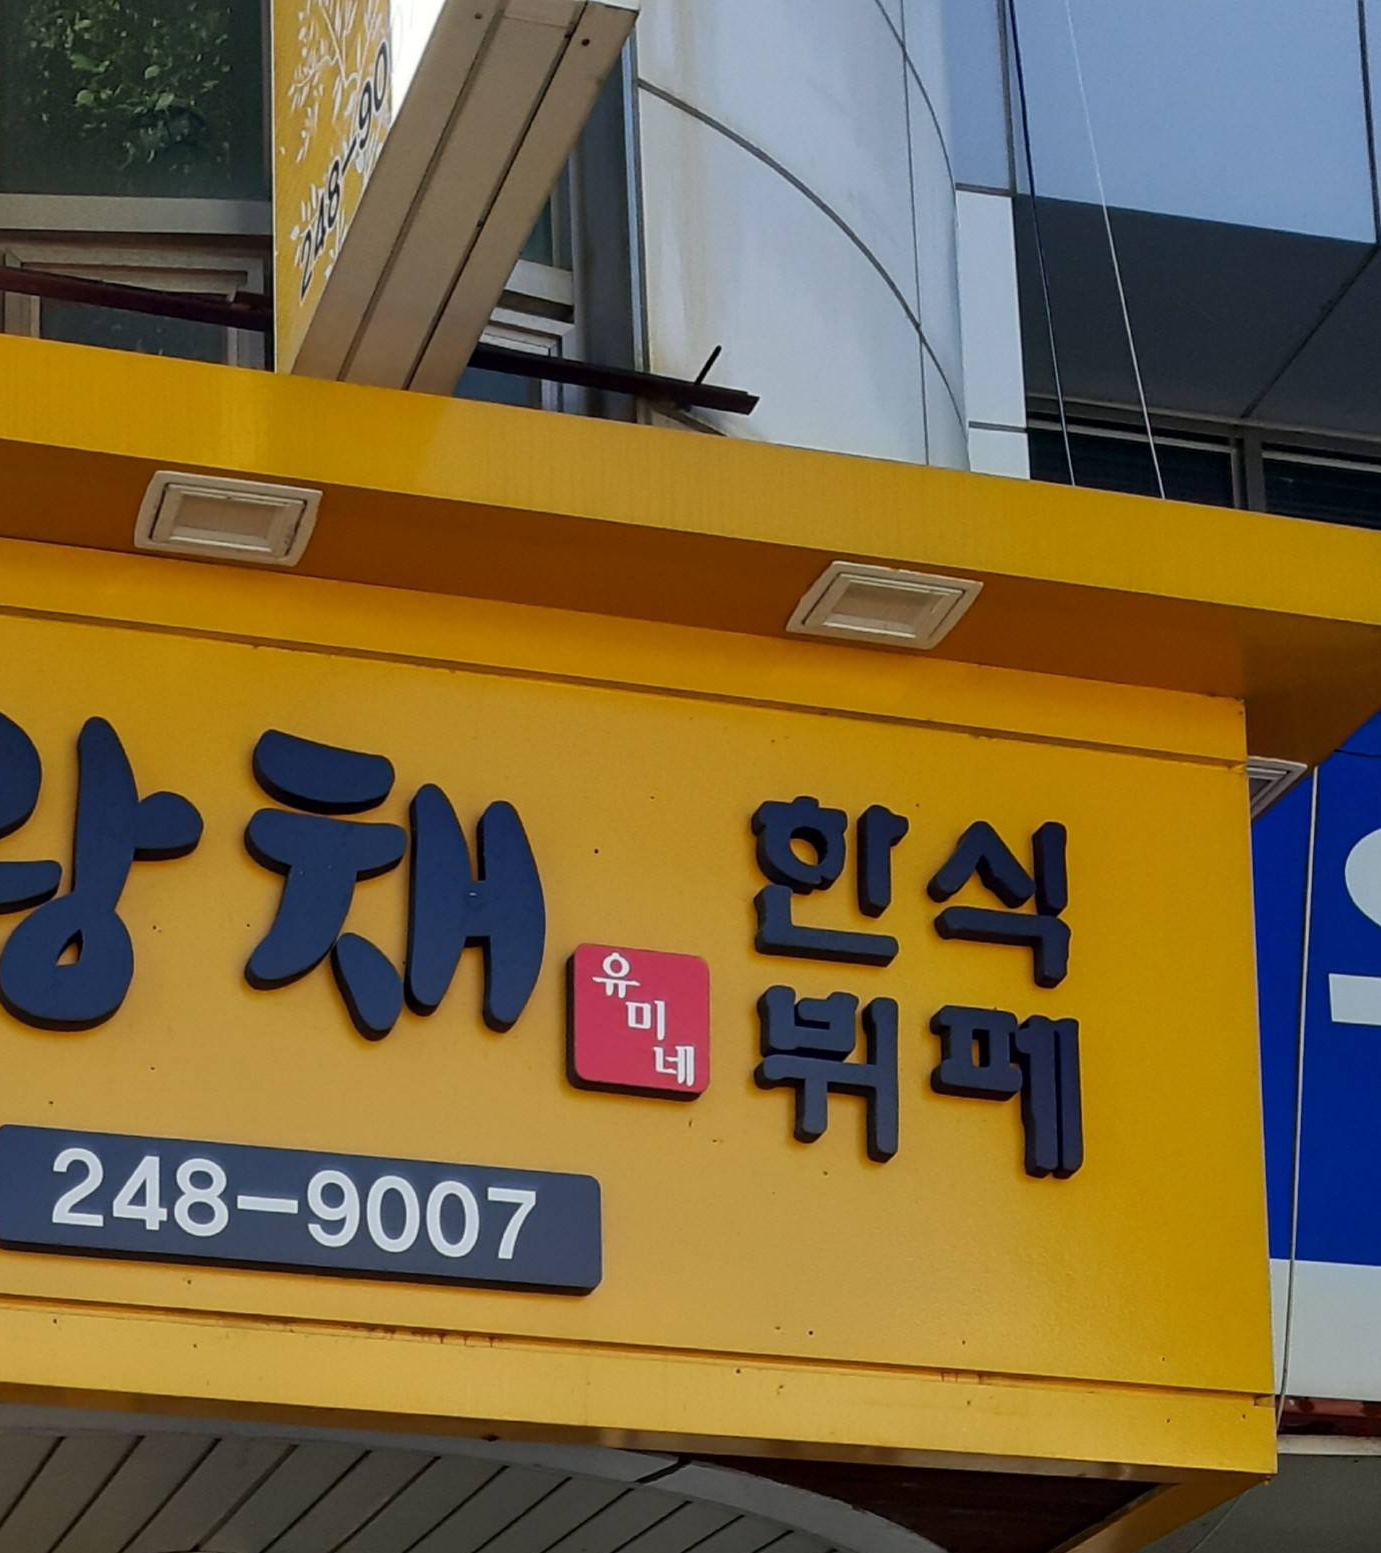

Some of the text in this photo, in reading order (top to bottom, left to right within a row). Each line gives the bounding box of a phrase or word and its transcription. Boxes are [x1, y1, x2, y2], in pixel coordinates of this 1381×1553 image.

[749, 795, 1073, 989] 한식
[591, 951, 696, 1088] 유미네
[752, 984, 1085, 1181] 뷔페
[51, 1146, 538, 1261] 248-9007
